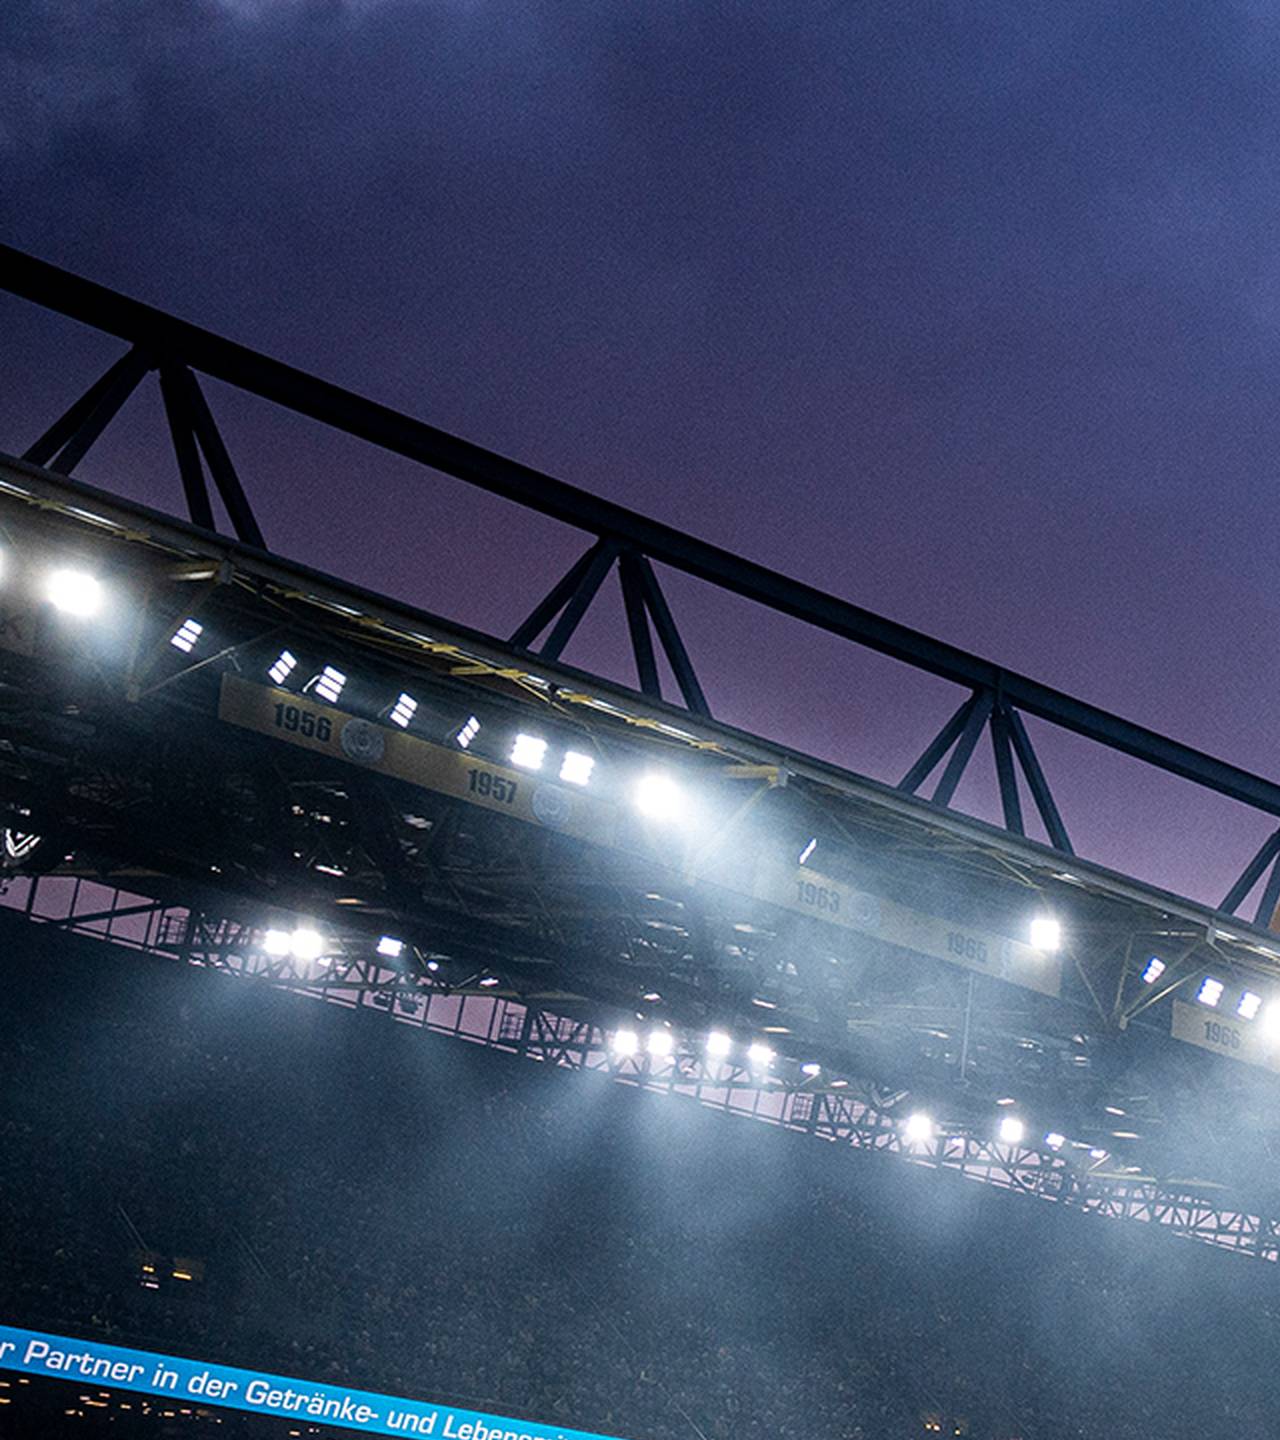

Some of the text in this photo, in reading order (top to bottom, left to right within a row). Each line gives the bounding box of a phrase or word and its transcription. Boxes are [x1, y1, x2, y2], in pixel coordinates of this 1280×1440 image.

[274, 703, 332, 742] 1956
[467, 768, 517, 804] 1957
[24, 1340, 144, 1383] Partner
[152, 1363, 178, 1389] in
[187, 1371, 237, 1400] der
[246, 1380, 379, 1424] Getränke-
[386, 1411, 436, 1435] und
